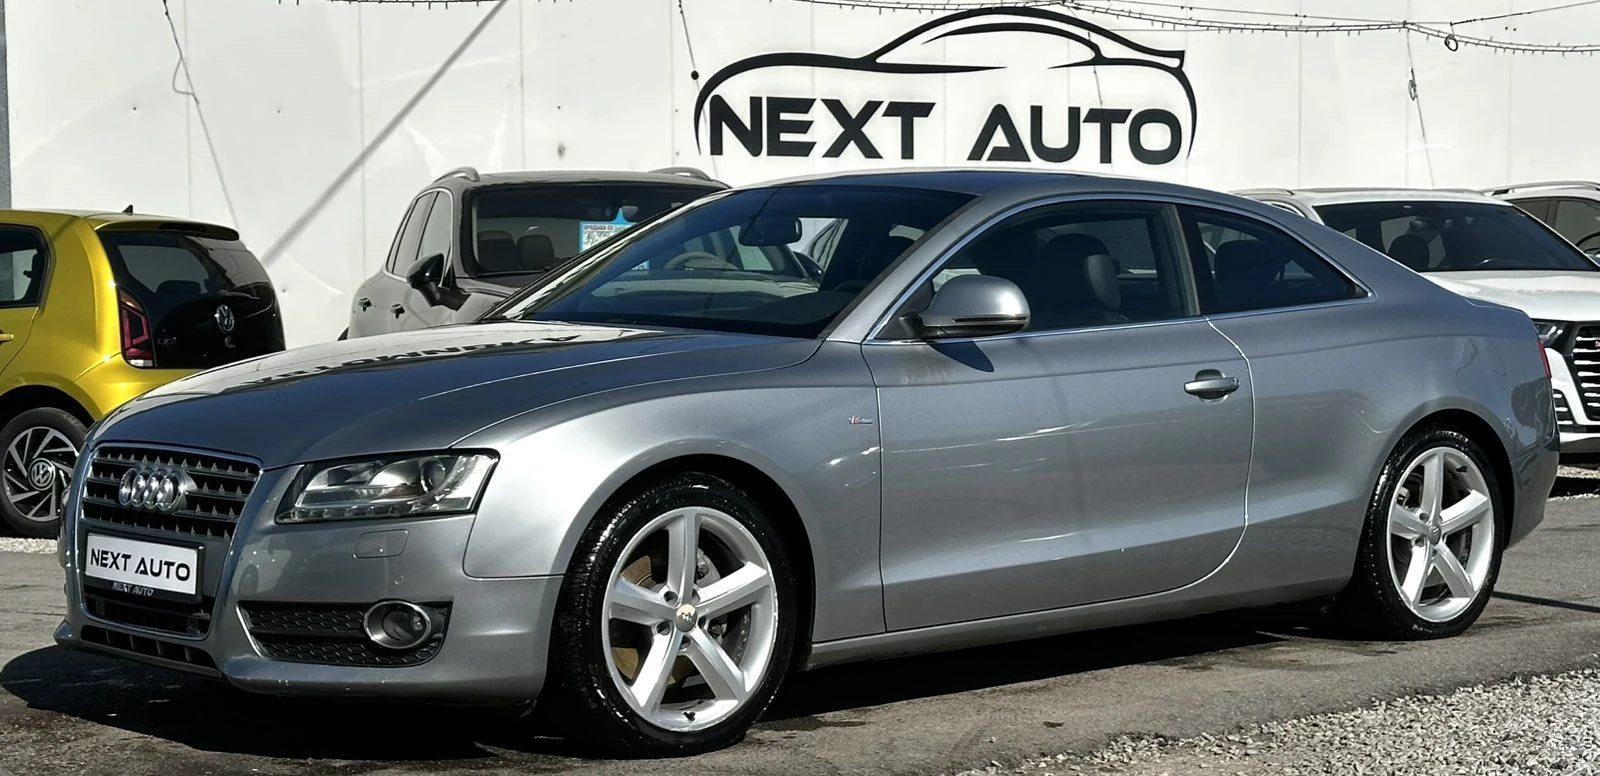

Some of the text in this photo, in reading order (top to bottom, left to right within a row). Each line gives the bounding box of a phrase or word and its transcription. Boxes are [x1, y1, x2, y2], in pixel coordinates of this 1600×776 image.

[710, 94, 1182, 165] NEXT AUTO
[90, 548, 191, 581] NEXT AUTO
[112, 582, 154, 597] NEXT AUTO
